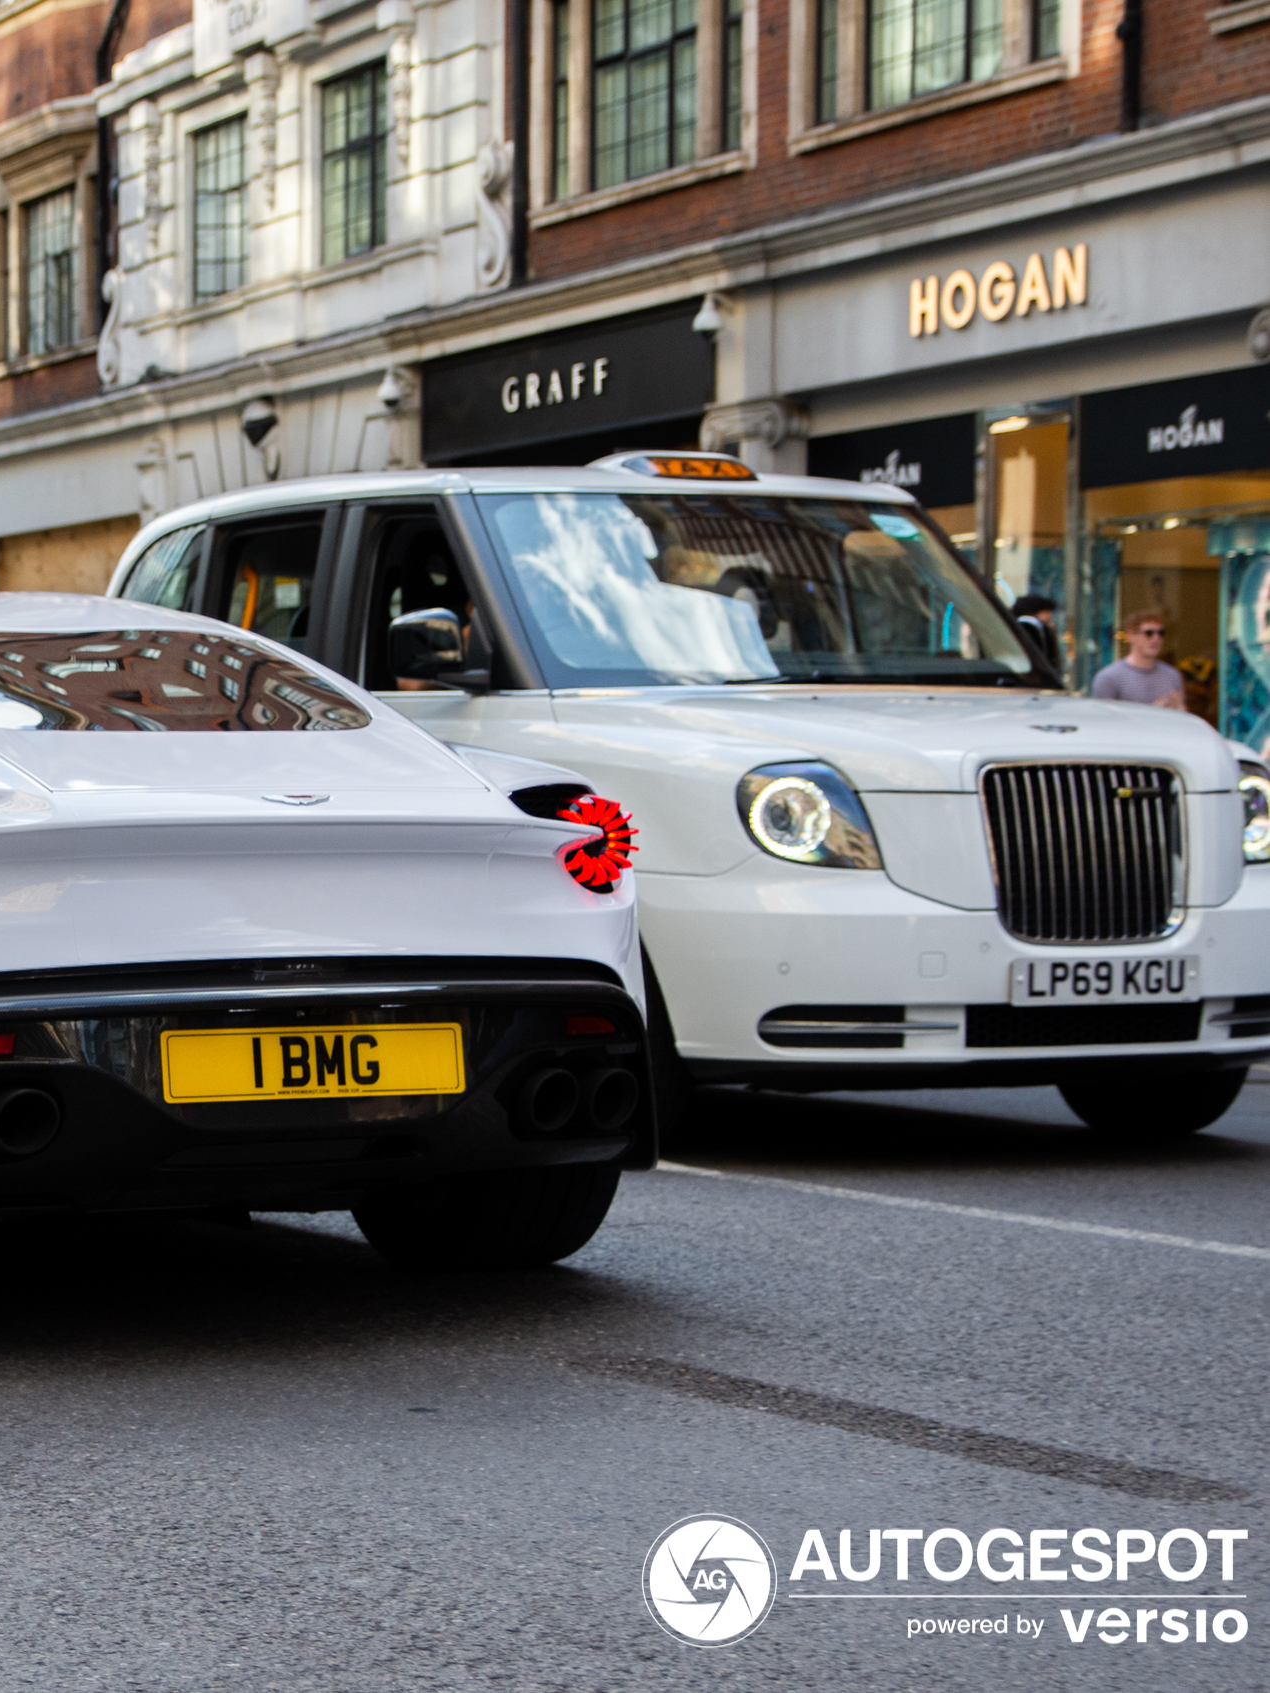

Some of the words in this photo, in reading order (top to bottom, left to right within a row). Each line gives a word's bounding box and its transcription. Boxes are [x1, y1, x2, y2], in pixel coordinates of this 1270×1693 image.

[909, 242, 1088, 337] HOGAN
[501, 357, 609, 413] GRAFF
[1147, 410, 1224, 453] HOGAN
[1028, 961, 1114, 997] LP69
[1123, 959, 1186, 995] KGU
[280, 1034, 381, 1088] BMG
